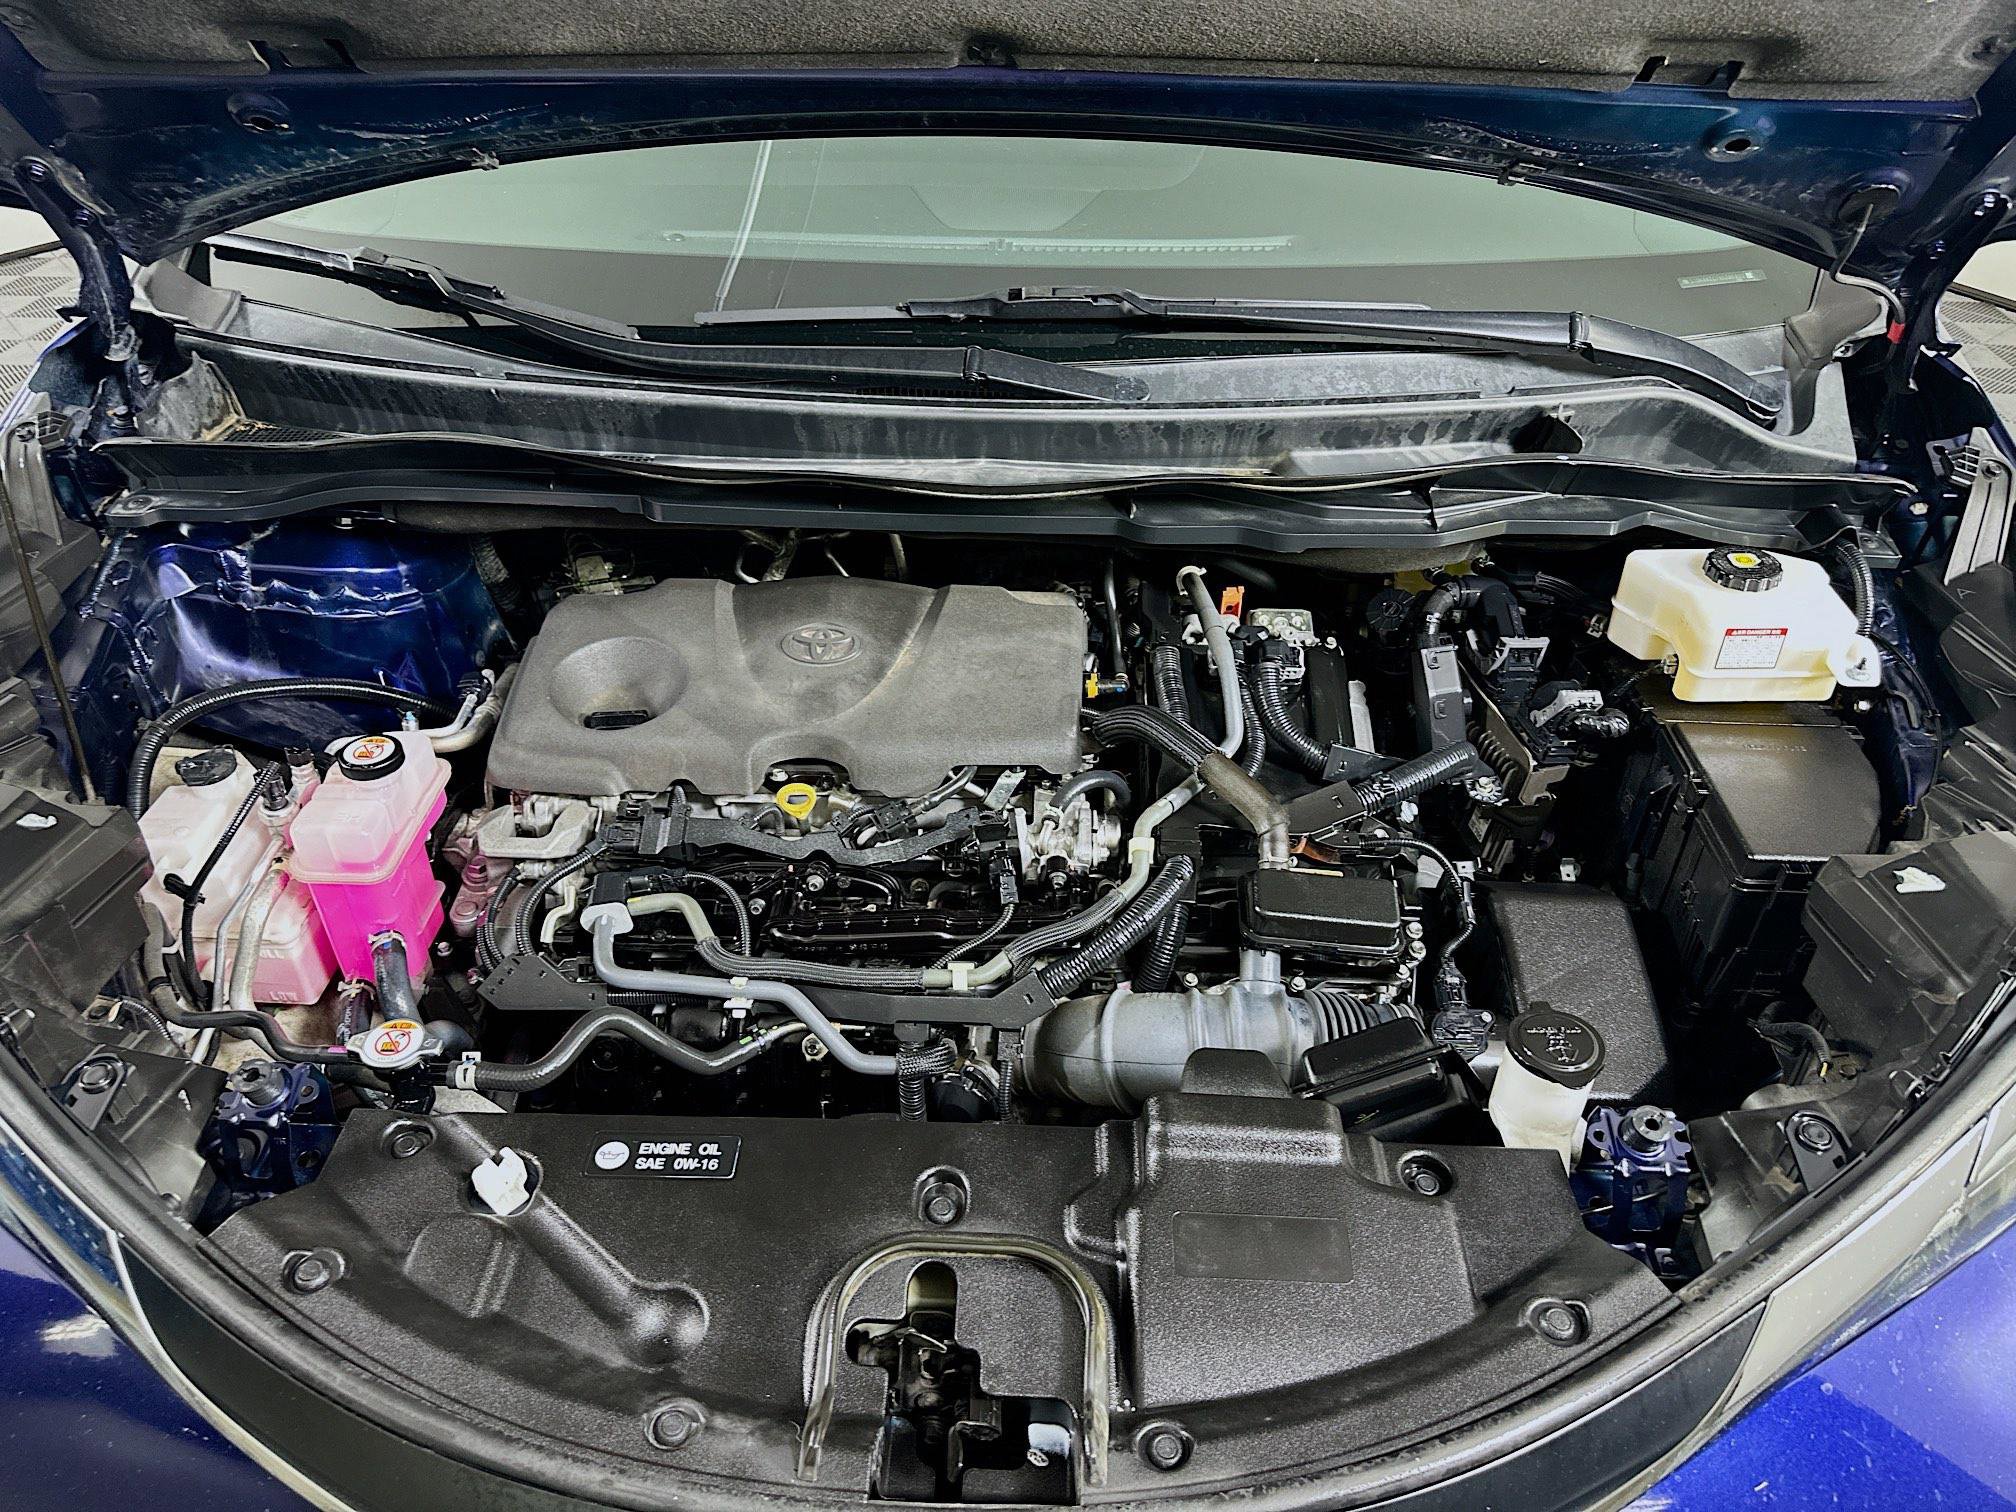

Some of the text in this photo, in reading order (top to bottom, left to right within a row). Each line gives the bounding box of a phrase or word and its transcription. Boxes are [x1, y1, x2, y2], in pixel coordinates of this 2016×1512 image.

[638, 1142, 722, 1155] ENGINE OIL
[635, 1157, 719, 1170] SAE 0W-16
